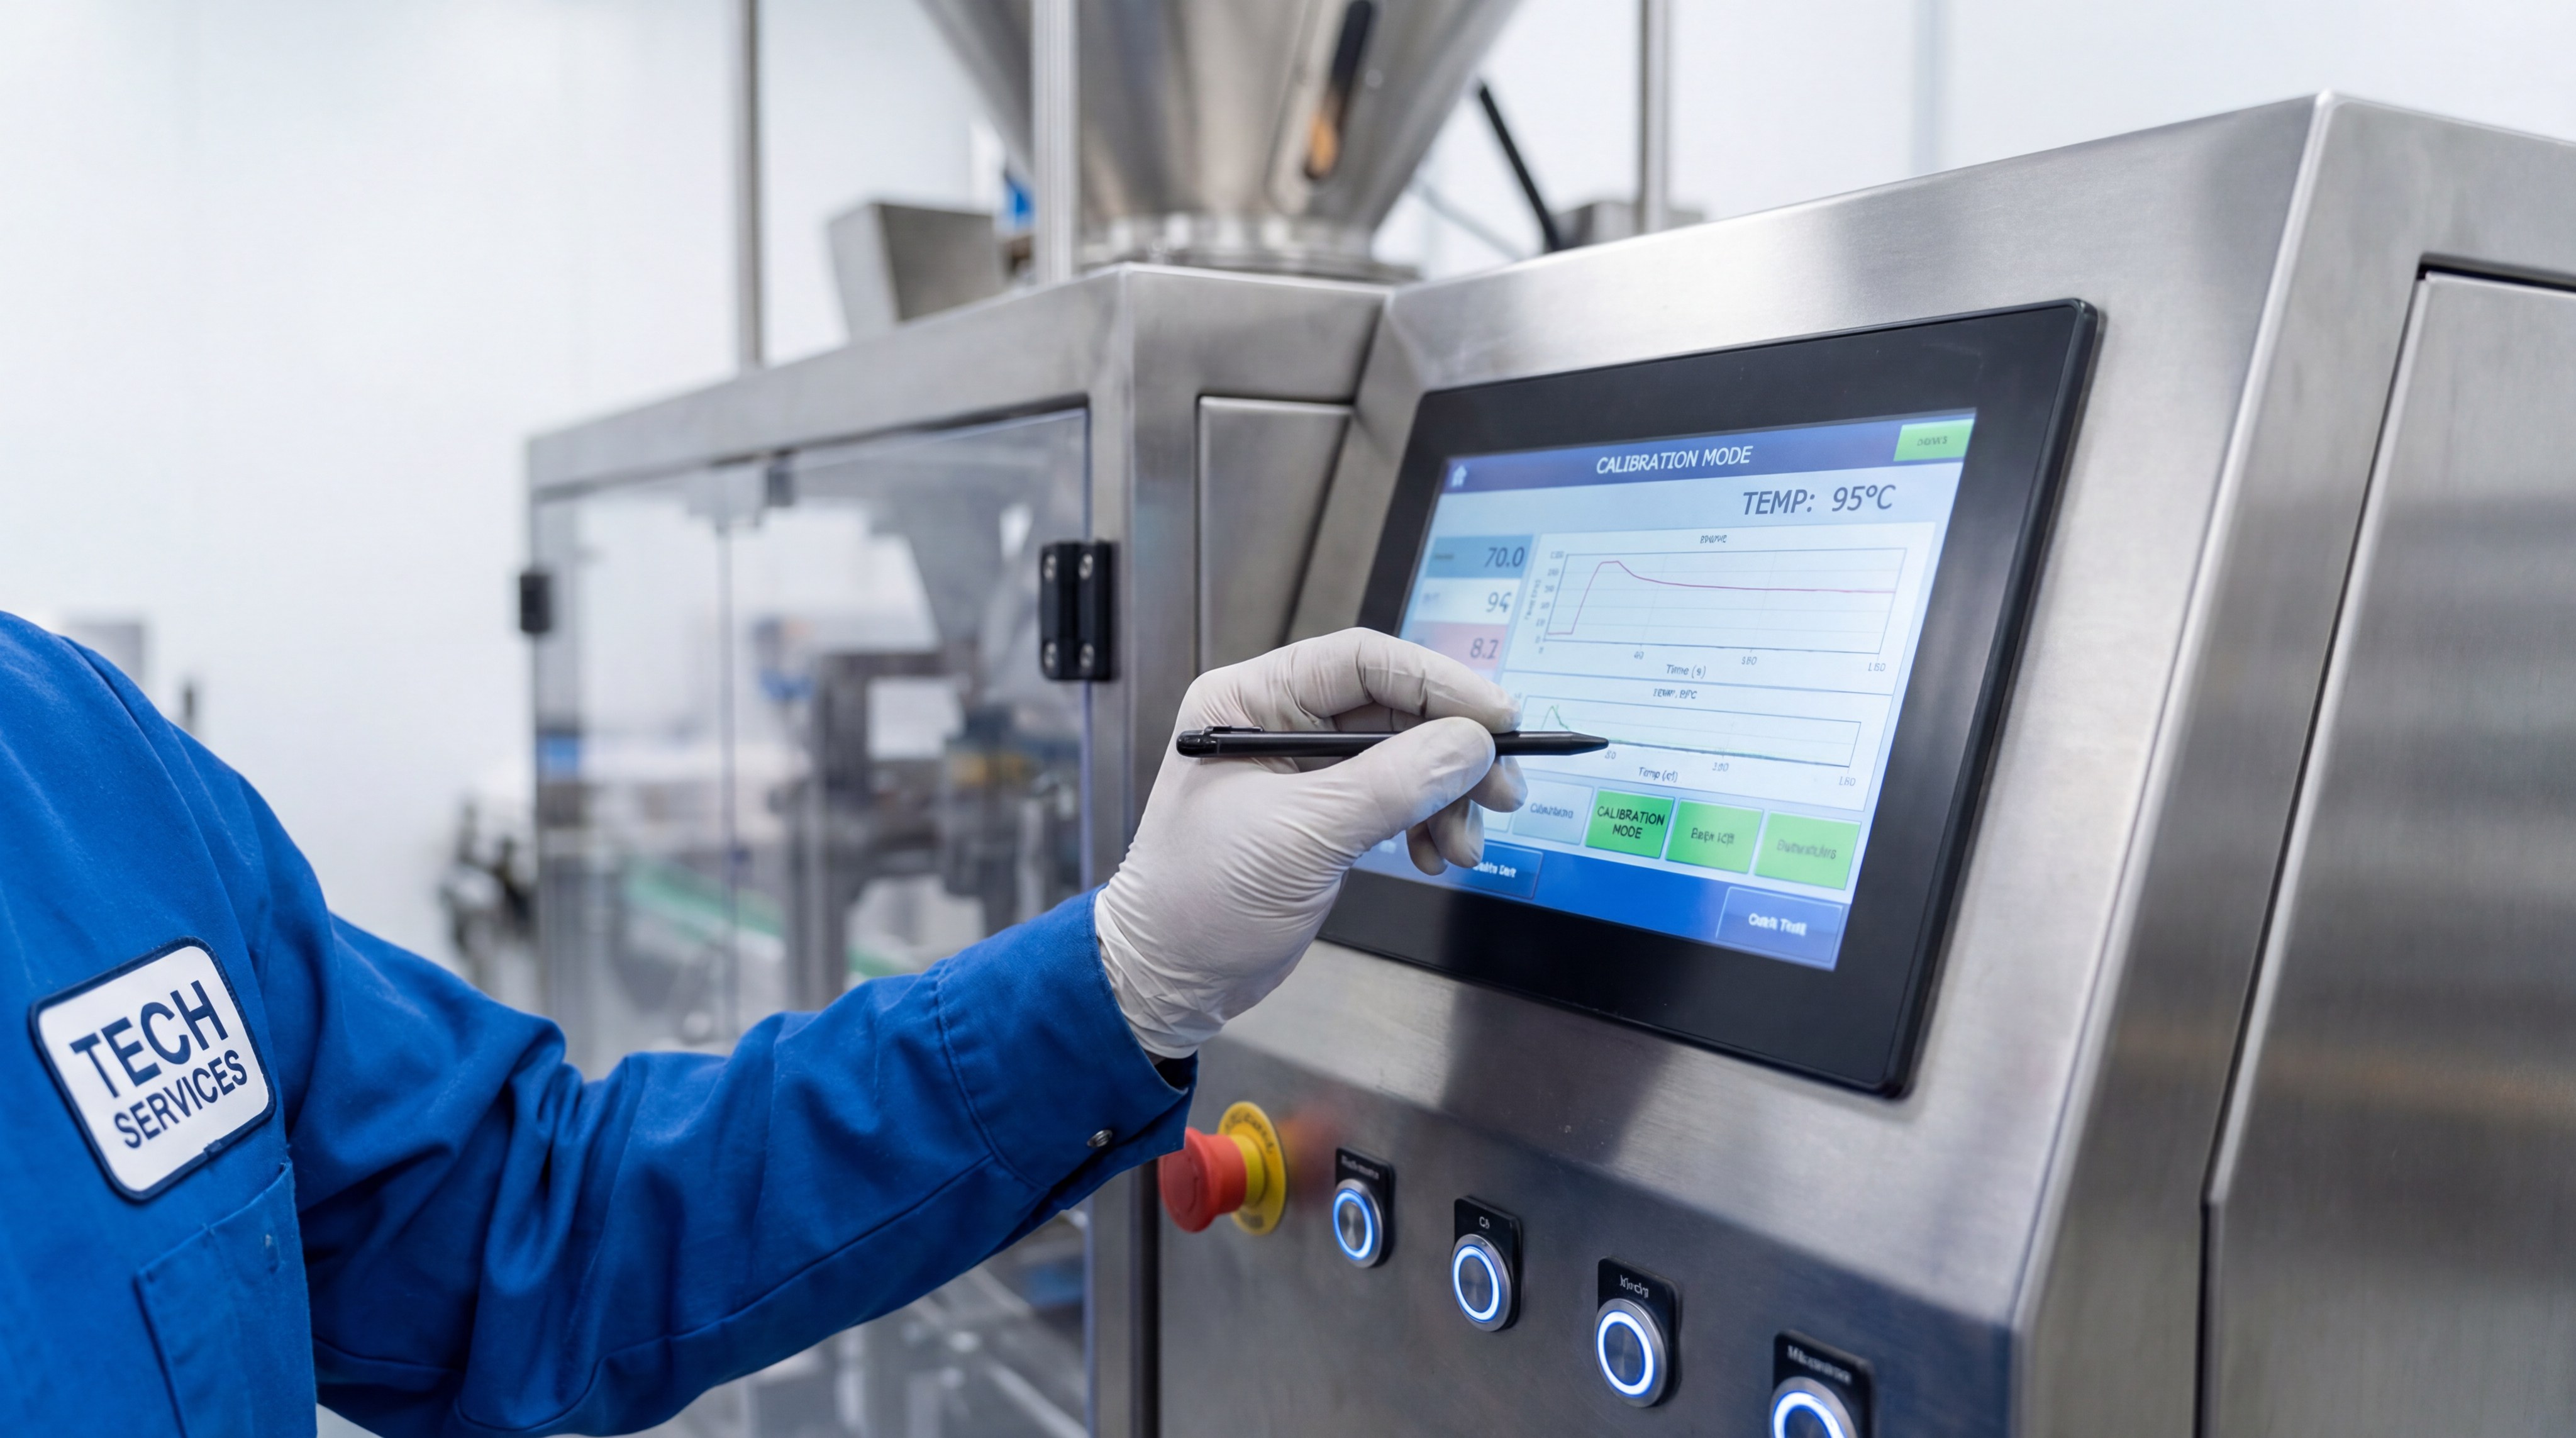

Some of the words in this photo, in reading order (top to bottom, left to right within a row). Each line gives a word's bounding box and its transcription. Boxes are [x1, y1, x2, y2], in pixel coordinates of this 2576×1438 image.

[1596, 450, 1699, 474] CALIBRATION
[1701, 445, 1753, 467] MODE
[1743, 489, 1816, 516] TEMP:
[1831, 484, 1897, 512] 95°C
[1484, 546, 1525, 569] 70.0
[1597, 806, 1666, 826] CALIBRATION
[70, 979, 229, 1099] TECH
[114, 1049, 248, 1149] SERVICES
